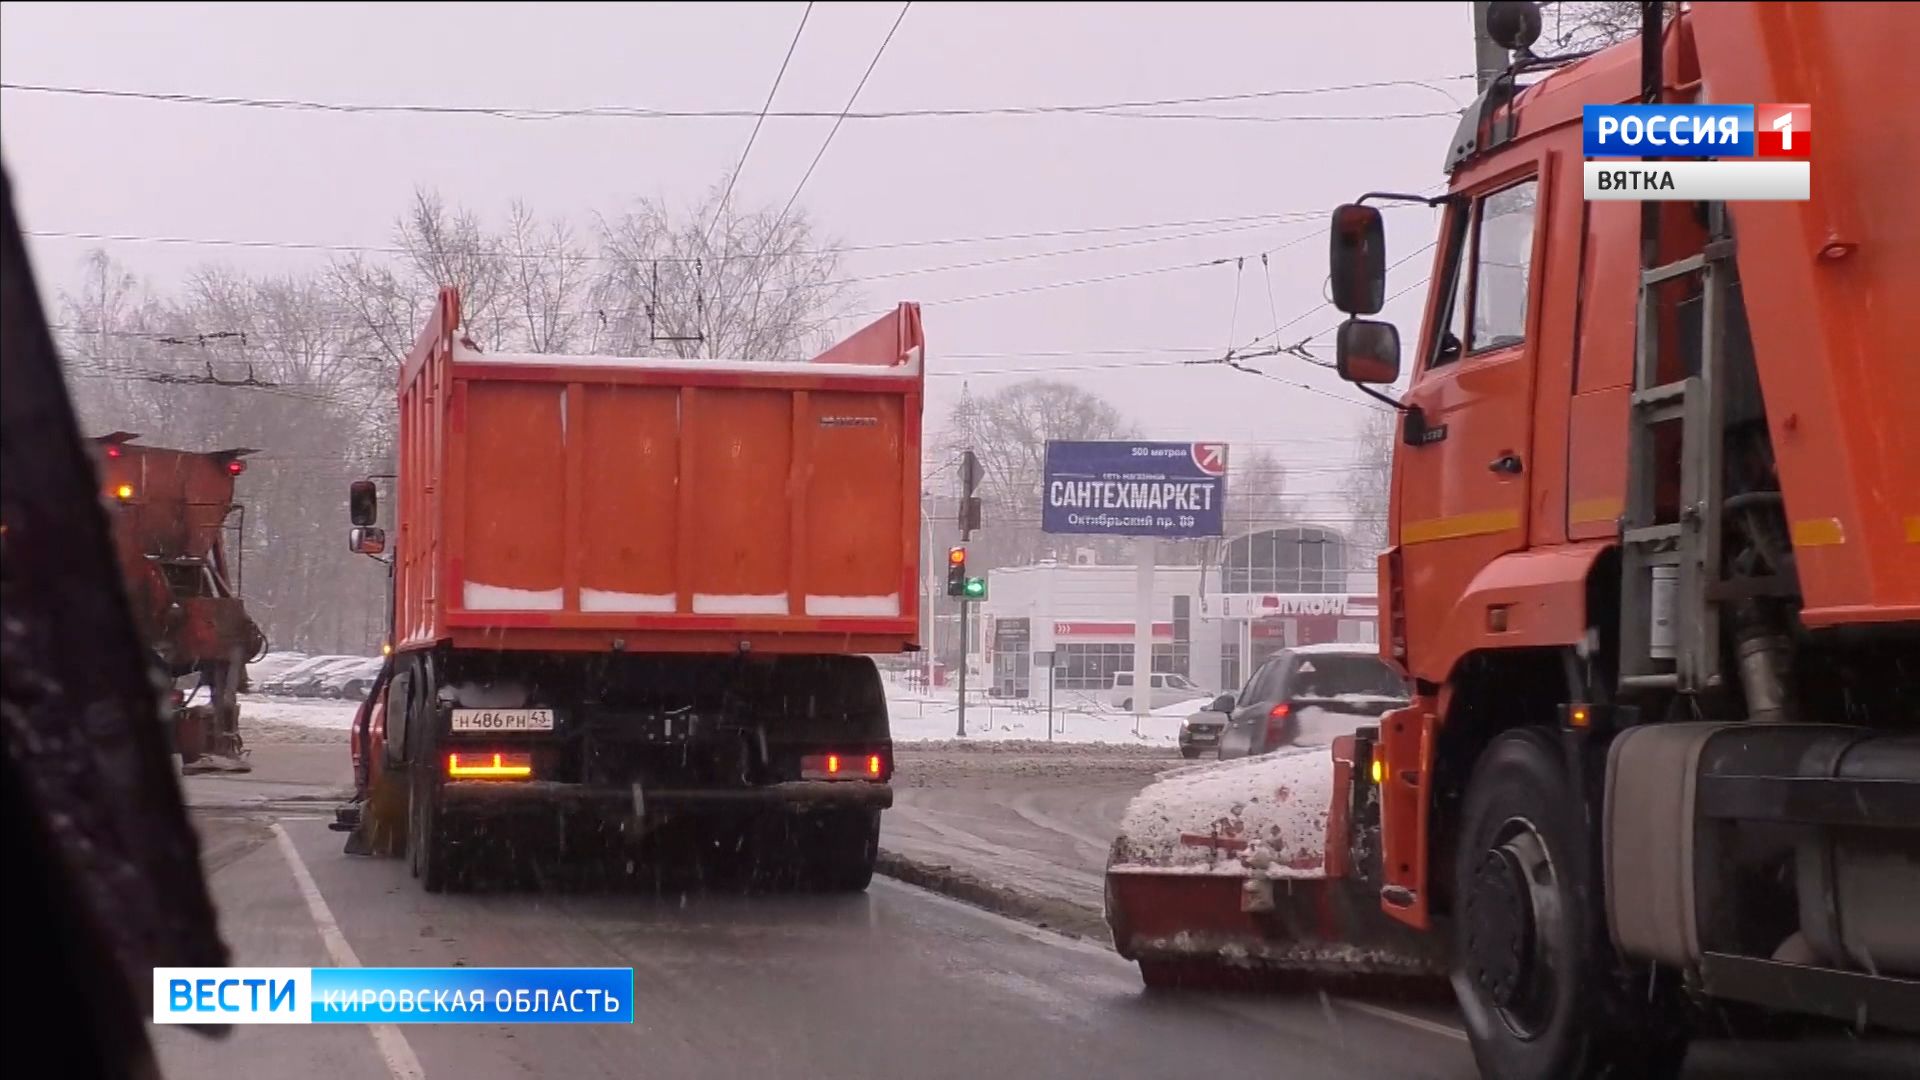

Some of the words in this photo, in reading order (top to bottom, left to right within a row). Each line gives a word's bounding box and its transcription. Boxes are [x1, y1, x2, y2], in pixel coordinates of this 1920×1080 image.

[1131, 447, 1149, 456] 500
[1150, 449, 1188, 457] метров
[1050, 481, 1216, 511] САНТЕХМАРКЕТ
[1068, 513, 1153, 528] Октябрьский
[1156, 518, 1177, 528] пр.
